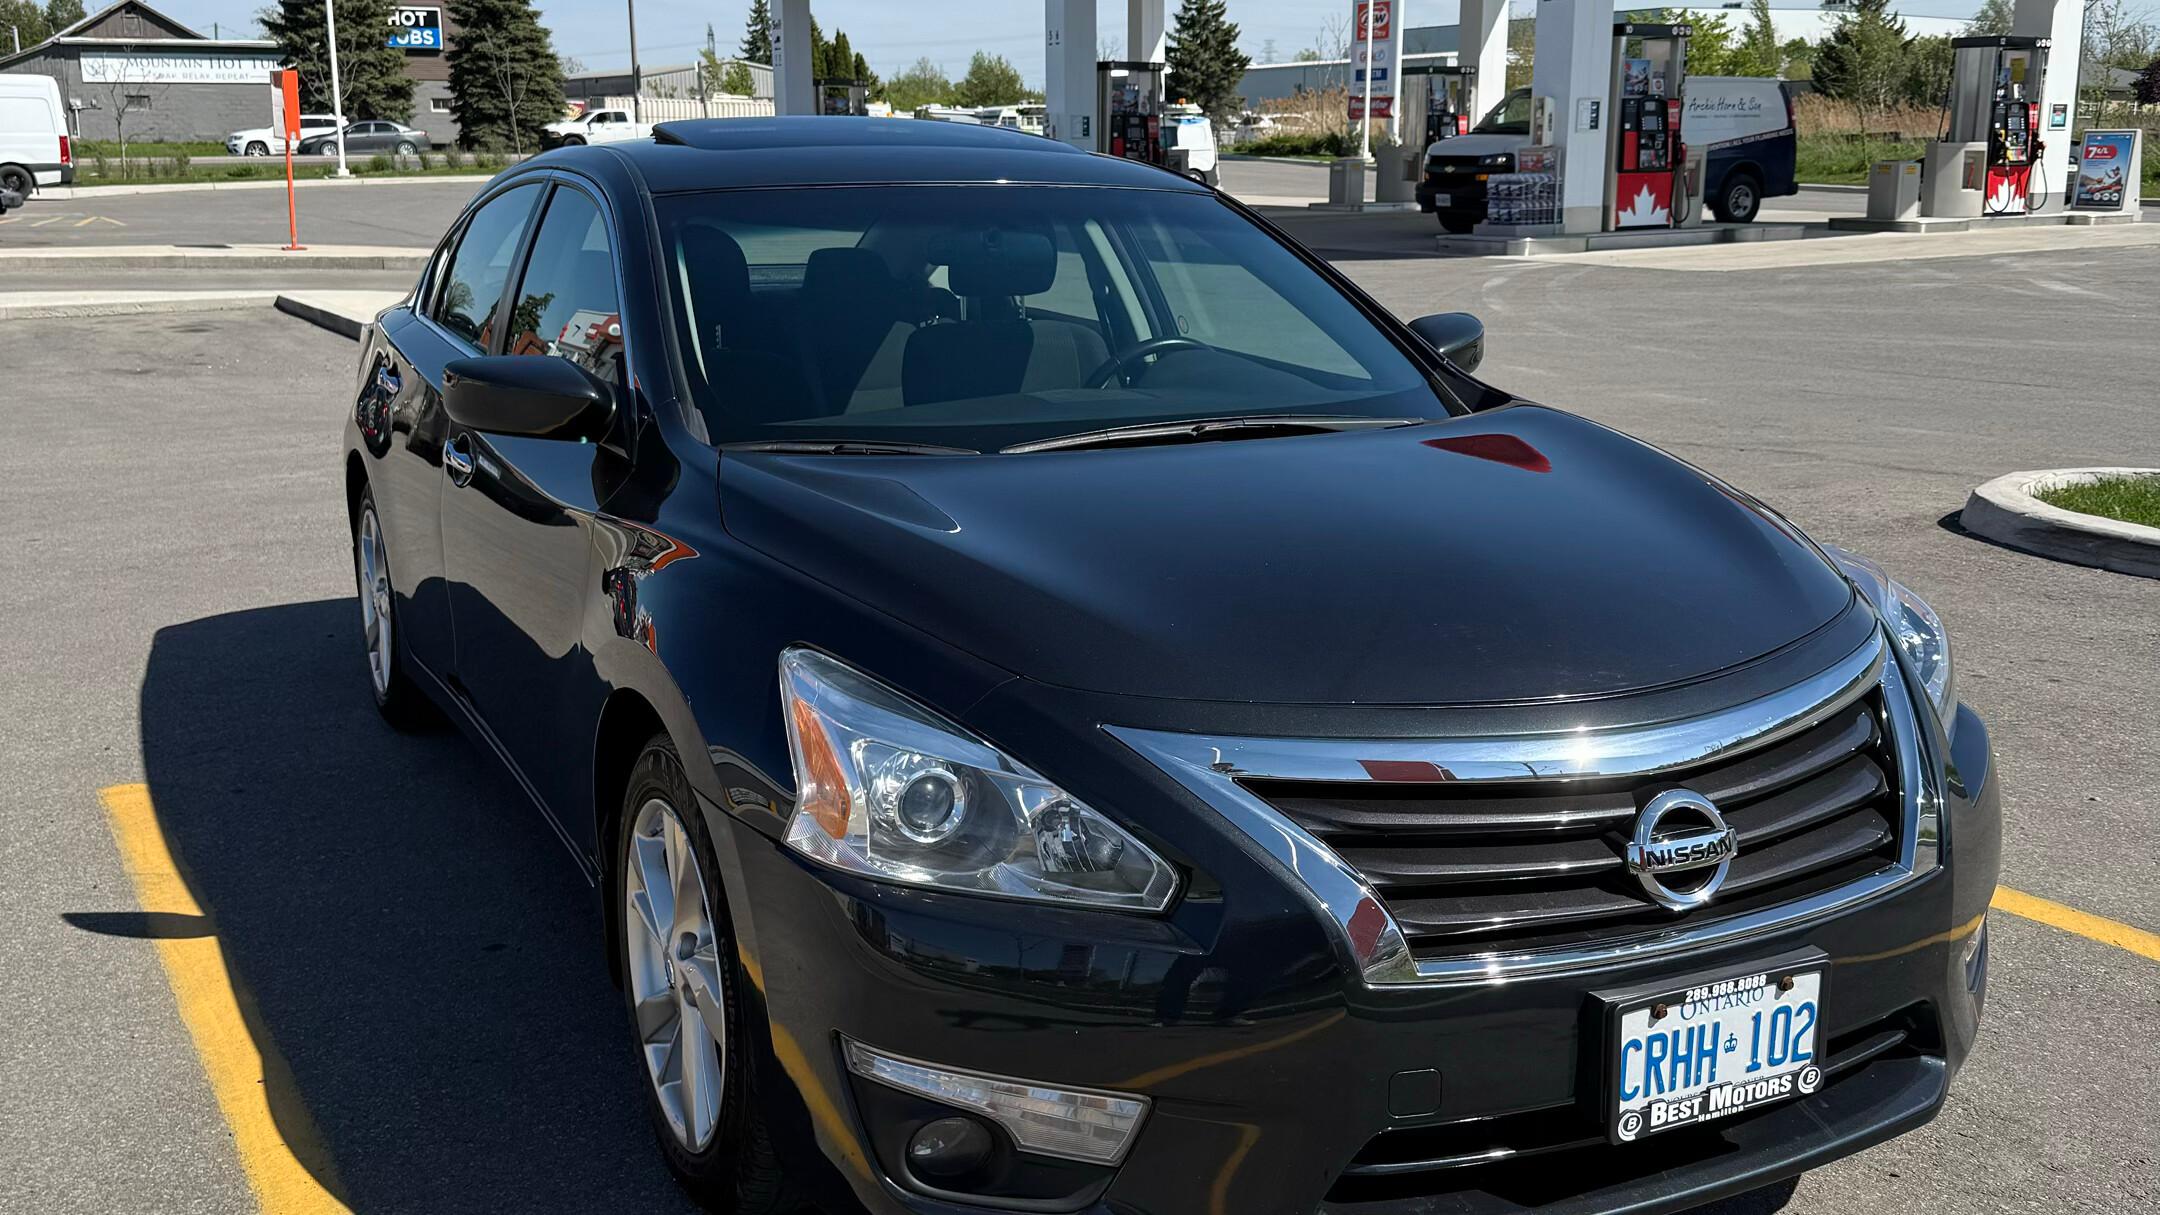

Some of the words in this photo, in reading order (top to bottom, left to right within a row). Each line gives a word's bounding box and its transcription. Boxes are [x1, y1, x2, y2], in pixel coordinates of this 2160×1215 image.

[387, 11, 428, 27] HOT
[387, 29, 434, 46] UBS
[209, 56, 243, 70] HOT
[1645, 836, 1732, 867] NISSAN
[1679, 986, 1765, 1021] ONTARIO
[1684, 974, 1768, 1004] 289.988.8088
[1619, 1021, 1721, 1102] CRHH
[1745, 1001, 1817, 1074] 102
[1650, 1098, 1703, 1127] BEST
[1709, 1074, 1793, 1112] MOTORS
[1697, 1105, 1744, 1123] Hamilton
